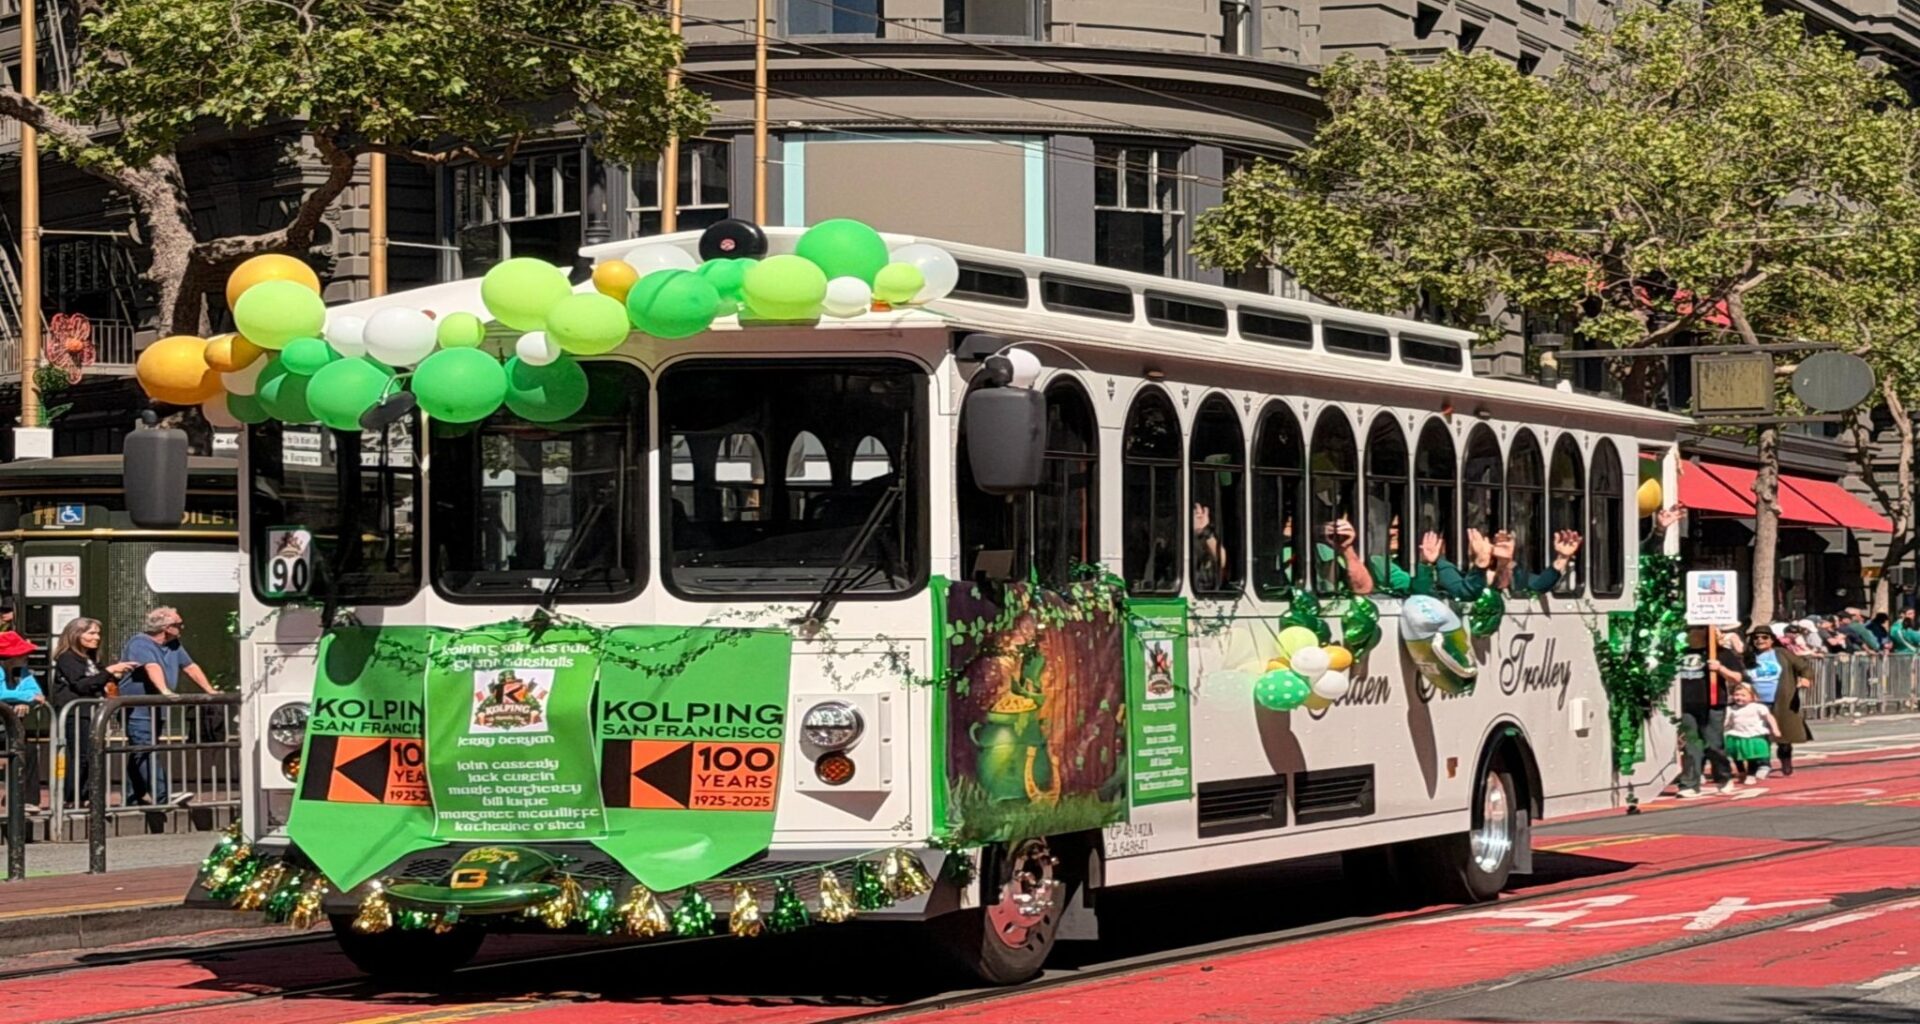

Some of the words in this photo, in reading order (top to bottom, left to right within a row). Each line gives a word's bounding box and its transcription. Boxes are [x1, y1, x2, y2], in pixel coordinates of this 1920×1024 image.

[180, 510, 237, 525] ILET
[271, 557, 309, 593] 90
[1500, 633, 1572, 711] Trolley
[313, 698, 424, 721] KOLPIN
[485, 703, 532, 716] KOLPING
[603, 700, 784, 725] KOLPING
[311, 719, 355, 733] SAN
[360, 722, 423, 735] FRANCI
[602, 723, 648, 736] SAN
[654, 724, 783, 739] FRANCISCO
[393, 742, 424, 767] 10
[697, 745, 776, 772] 100
[394, 769, 426, 783] YEA
[697, 774, 773, 788] YEARS
[390, 789, 428, 802] 1925-2
[693, 795, 771, 807] 1925-2025
